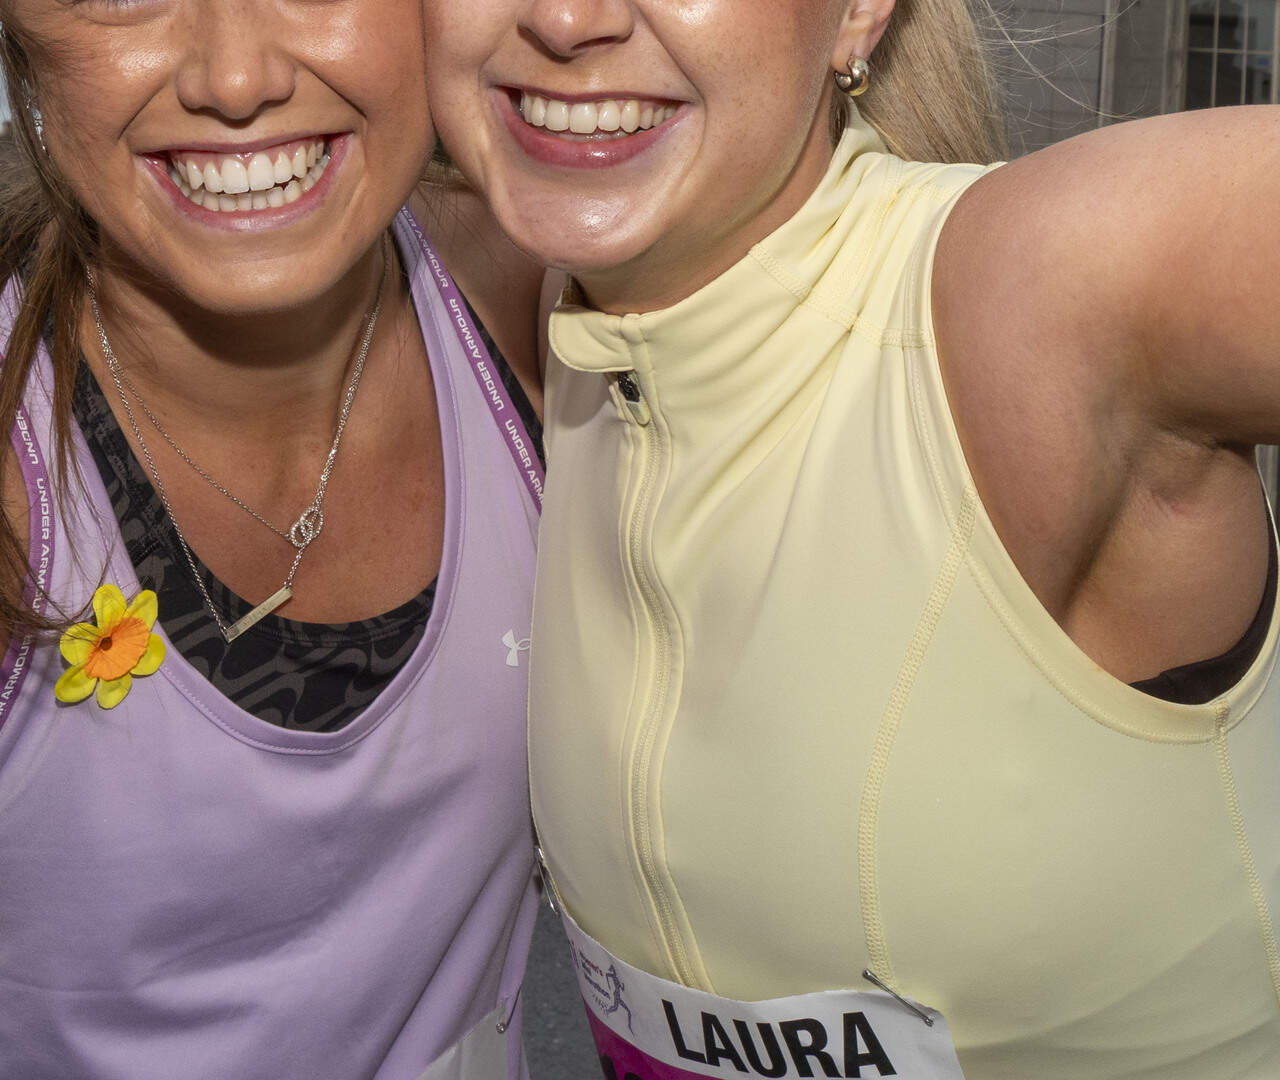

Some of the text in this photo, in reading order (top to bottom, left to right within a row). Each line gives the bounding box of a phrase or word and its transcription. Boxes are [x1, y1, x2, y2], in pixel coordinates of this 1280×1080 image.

[449, 298, 505, 412] UNDER ARMOUR
[505, 419, 545, 505] UNDER ARM
[36, 477, 50, 540] UNDER
[661, 998, 896, 1079] LAURA
